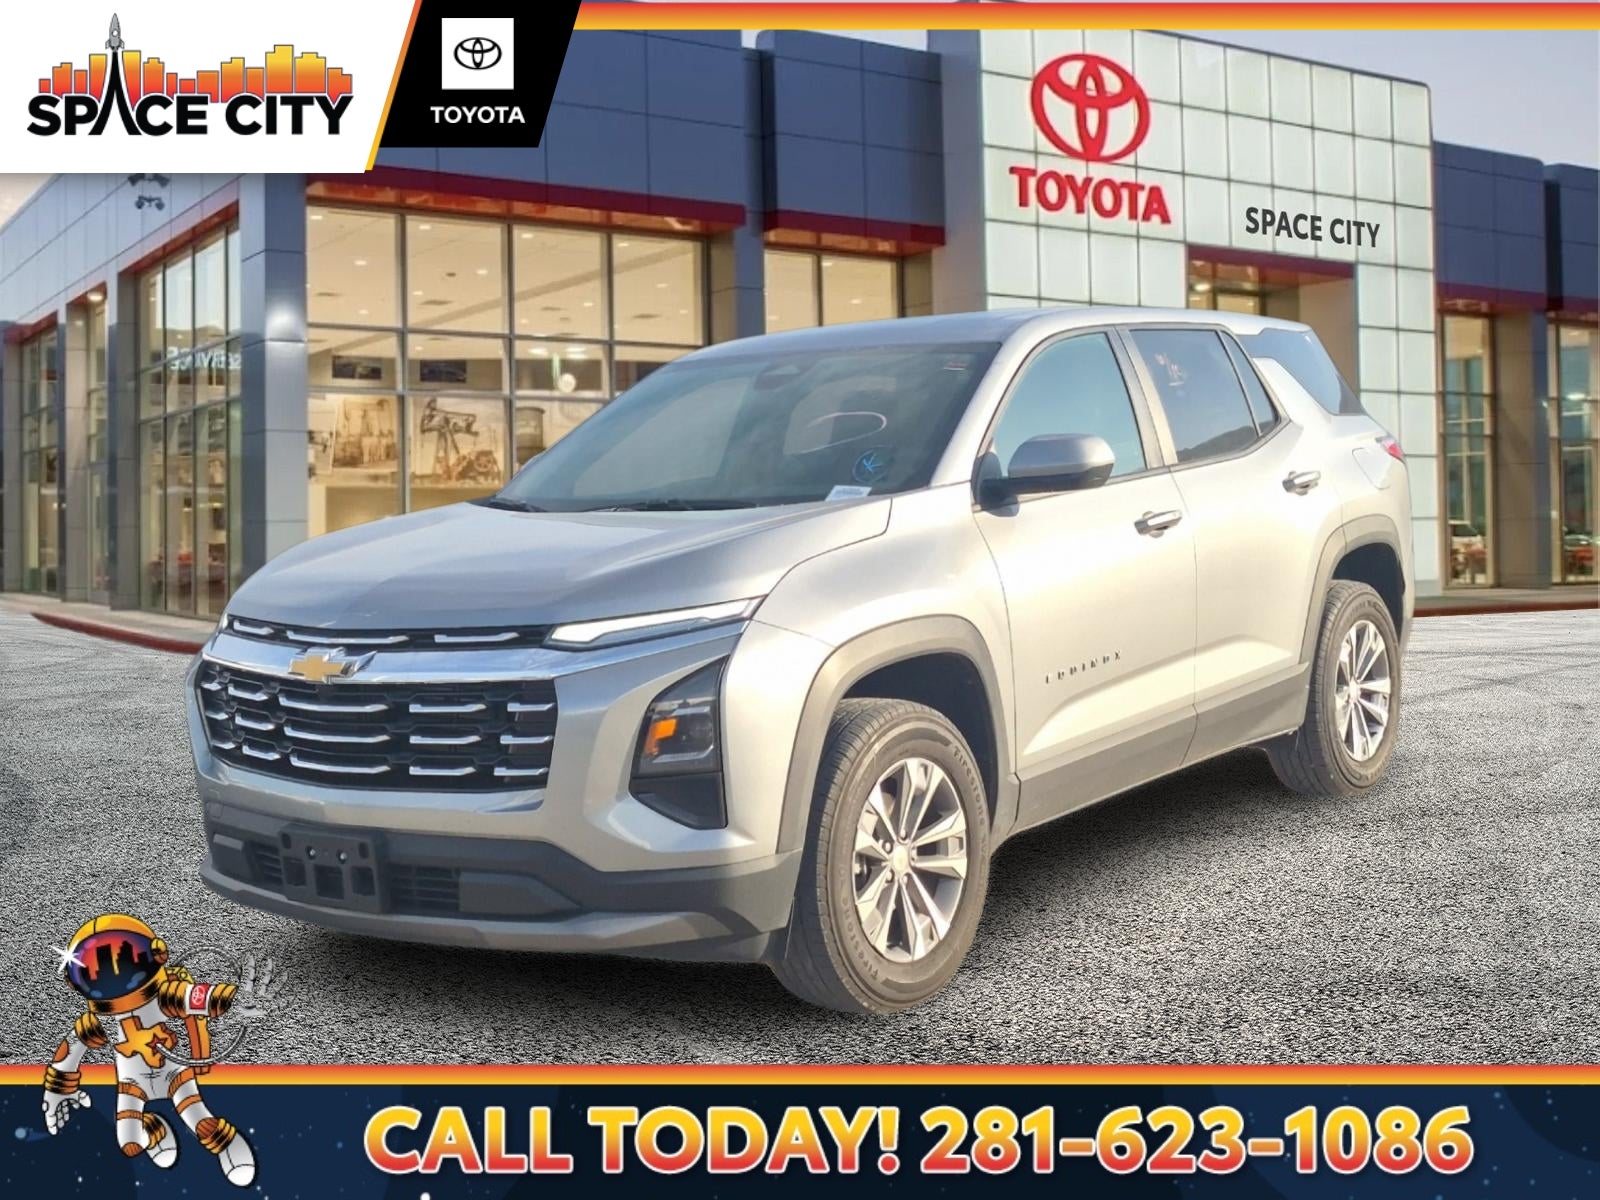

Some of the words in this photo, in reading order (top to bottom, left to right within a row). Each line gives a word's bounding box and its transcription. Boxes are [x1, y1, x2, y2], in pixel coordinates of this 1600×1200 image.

[1009, 167, 1171, 224] TOYOTA
[1245, 207, 1322, 242] SPACE
[1329, 218, 1381, 248] CITY
